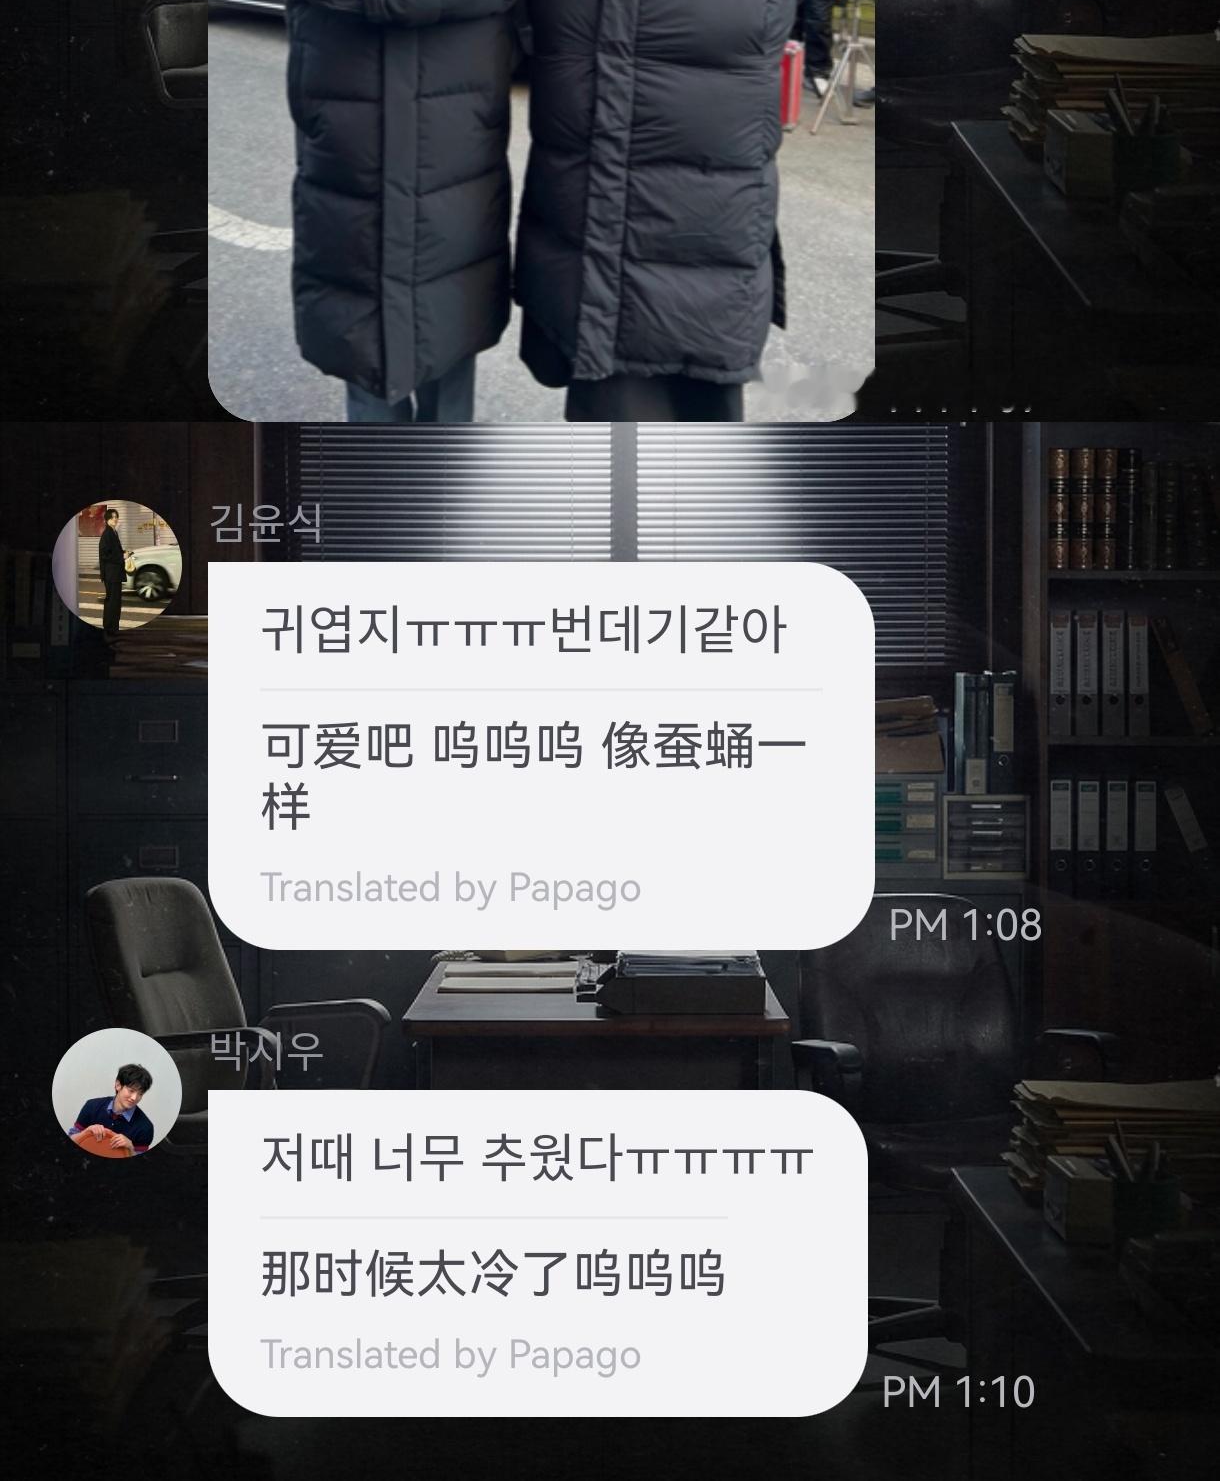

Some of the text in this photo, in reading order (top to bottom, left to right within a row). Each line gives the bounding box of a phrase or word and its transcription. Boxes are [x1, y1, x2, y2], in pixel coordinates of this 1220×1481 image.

[210, 503, 322, 545] 김윤식
[261, 604, 788, 655] 귀엽지ㅠㅠㅠ번데기같아
[261, 720, 808, 770] 可爱吧 呜呜呜 像蚕蛹一
[261, 781, 312, 831] 样
[260, 870, 641, 911] Translated by Papago
[891, 908, 1041, 940] PM 1:08
[210, 1031, 324, 1073] 박시우
[261, 1132, 814, 1183] 저때 너무 추웠다ㅠㅠㅠㅠ
[261, 1248, 726, 1298] 那时候太冷了呜呜呜
[260, 1337, 641, 1378] Translated by Papago
[884, 1375, 1034, 1407] PM 1:10
